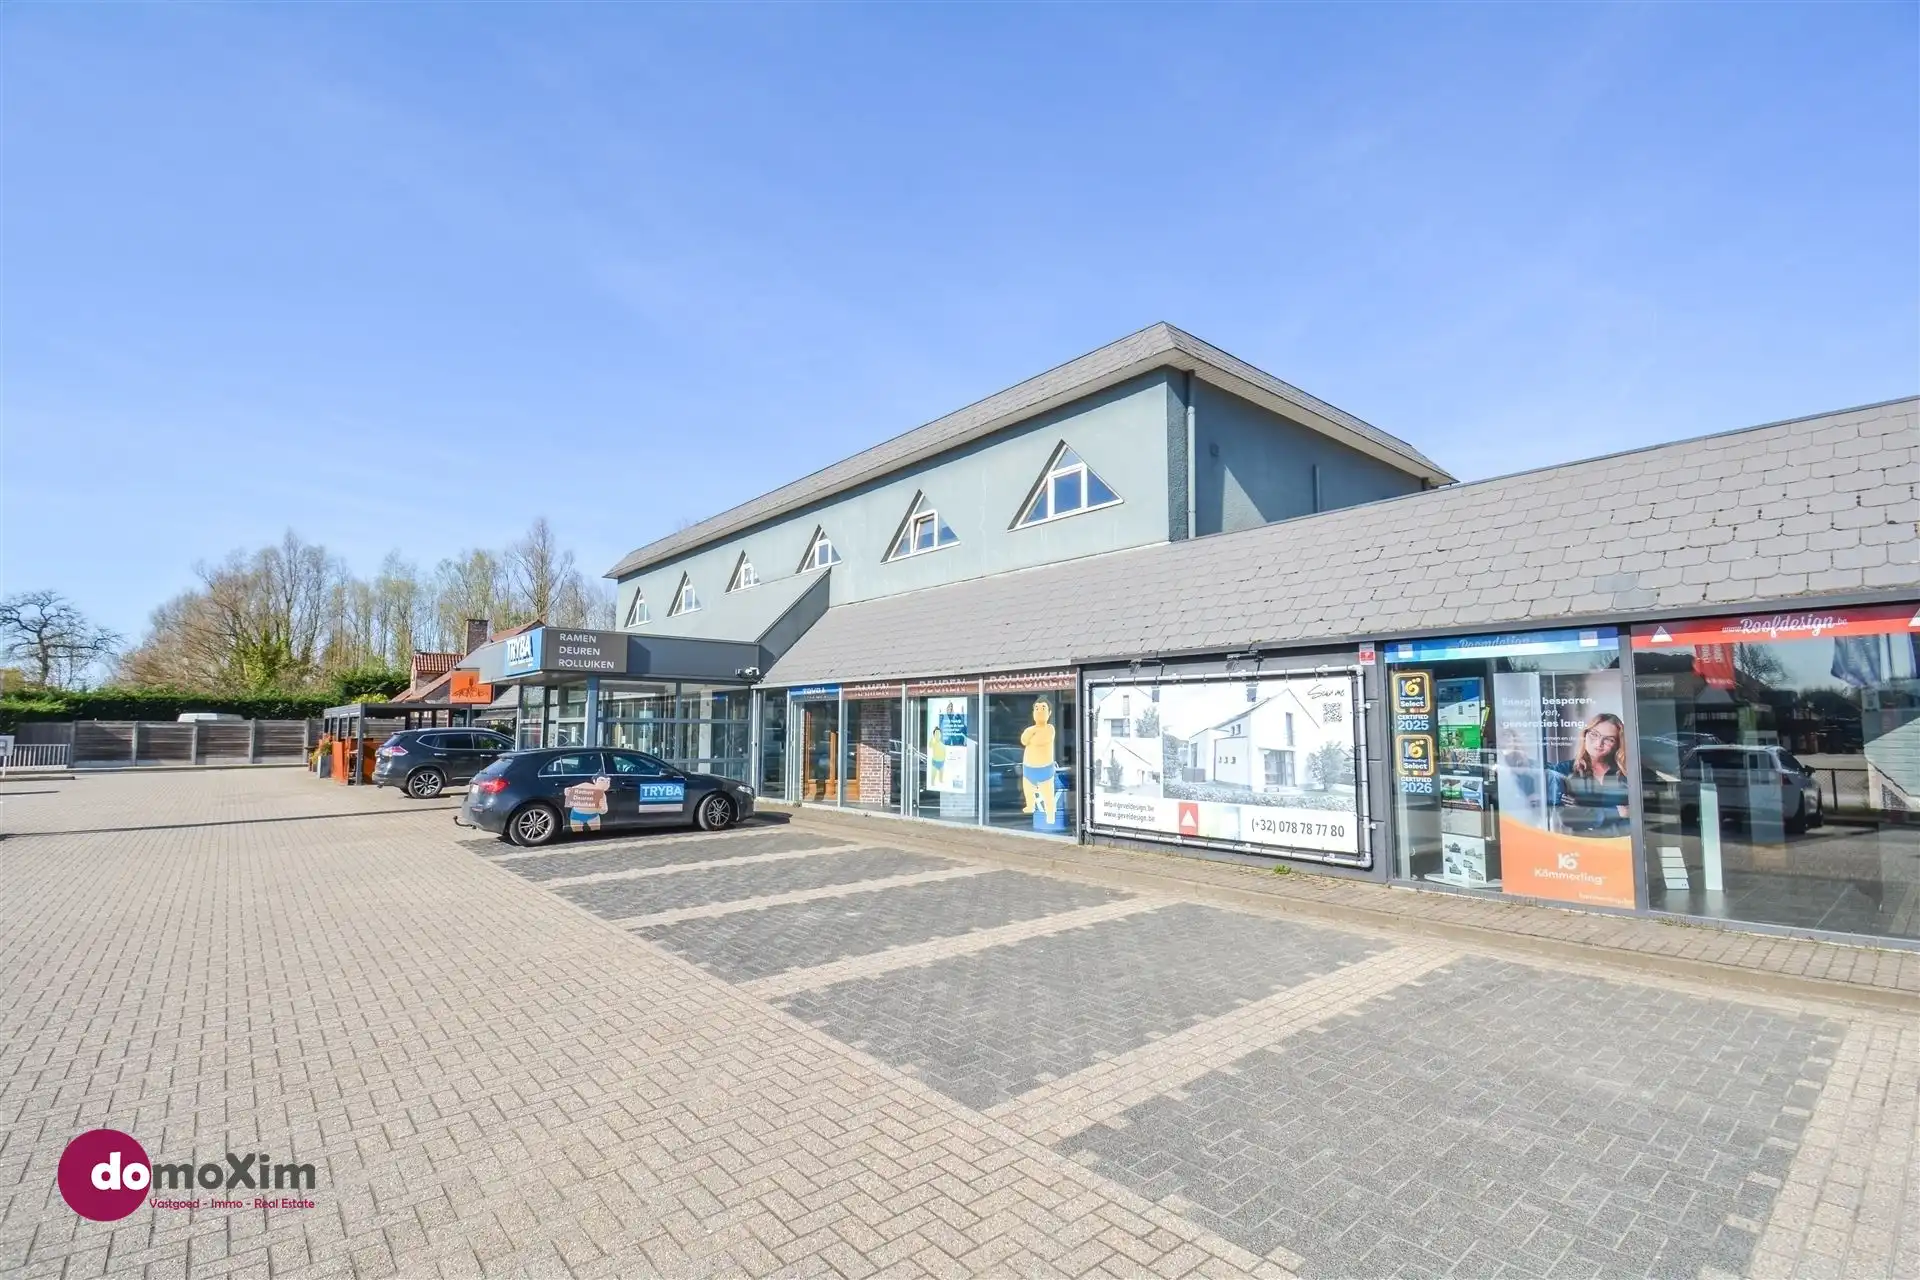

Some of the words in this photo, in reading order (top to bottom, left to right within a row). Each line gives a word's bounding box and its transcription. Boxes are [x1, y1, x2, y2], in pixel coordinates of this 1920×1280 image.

[559, 633, 597, 643] RAMEN
[559, 646, 600, 656] DEUREN
[558, 658, 614, 669] ROLLUIKEN
[989, 671, 1070, 690] ROLLUIKEN
[919, 679, 966, 694] DEUREN
[1400, 700, 1425, 708] Select
[1542, 697, 1596, 707] besparen.
[1397, 720, 1429, 731] 2025
[1560, 719, 1588, 729] lang.
[1403, 762, 1428, 770] Select
[643, 785, 683, 797] TRYBA
[1400, 782, 1433, 793] 2026
[1251, 818, 1276, 834] (+32)
[1278, 820, 1298, 834] 078
[1300, 822, 1313, 835] 78
[1315, 823, 1328, 836] 77
[1330, 824, 1345, 838] 80
